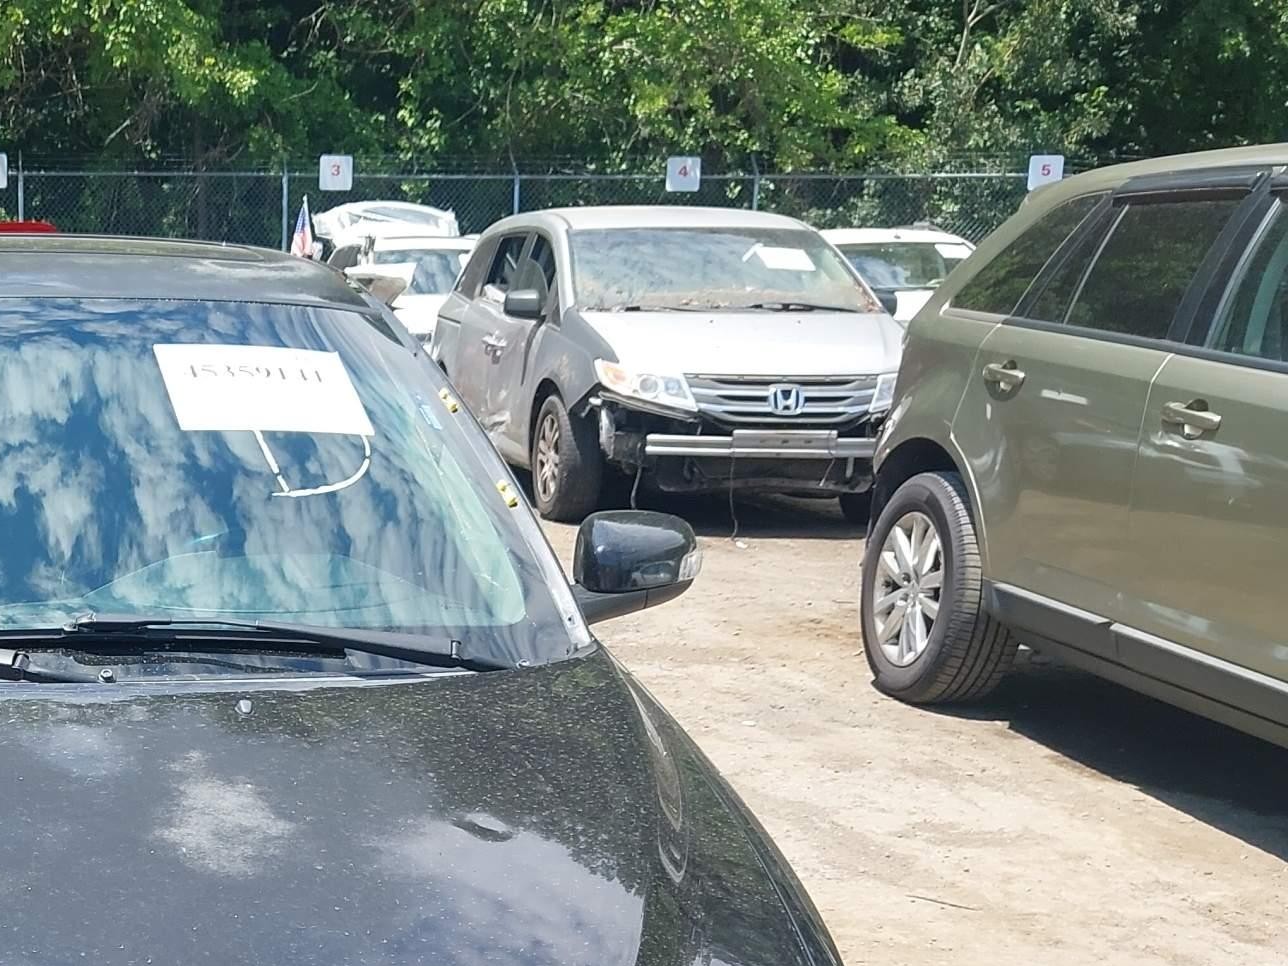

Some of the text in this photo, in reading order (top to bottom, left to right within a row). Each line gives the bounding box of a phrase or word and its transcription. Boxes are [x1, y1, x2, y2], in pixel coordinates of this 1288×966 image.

[330, 163, 341, 177] 3
[677, 165, 689, 177] 4
[1040, 163, 1052, 177] 5
